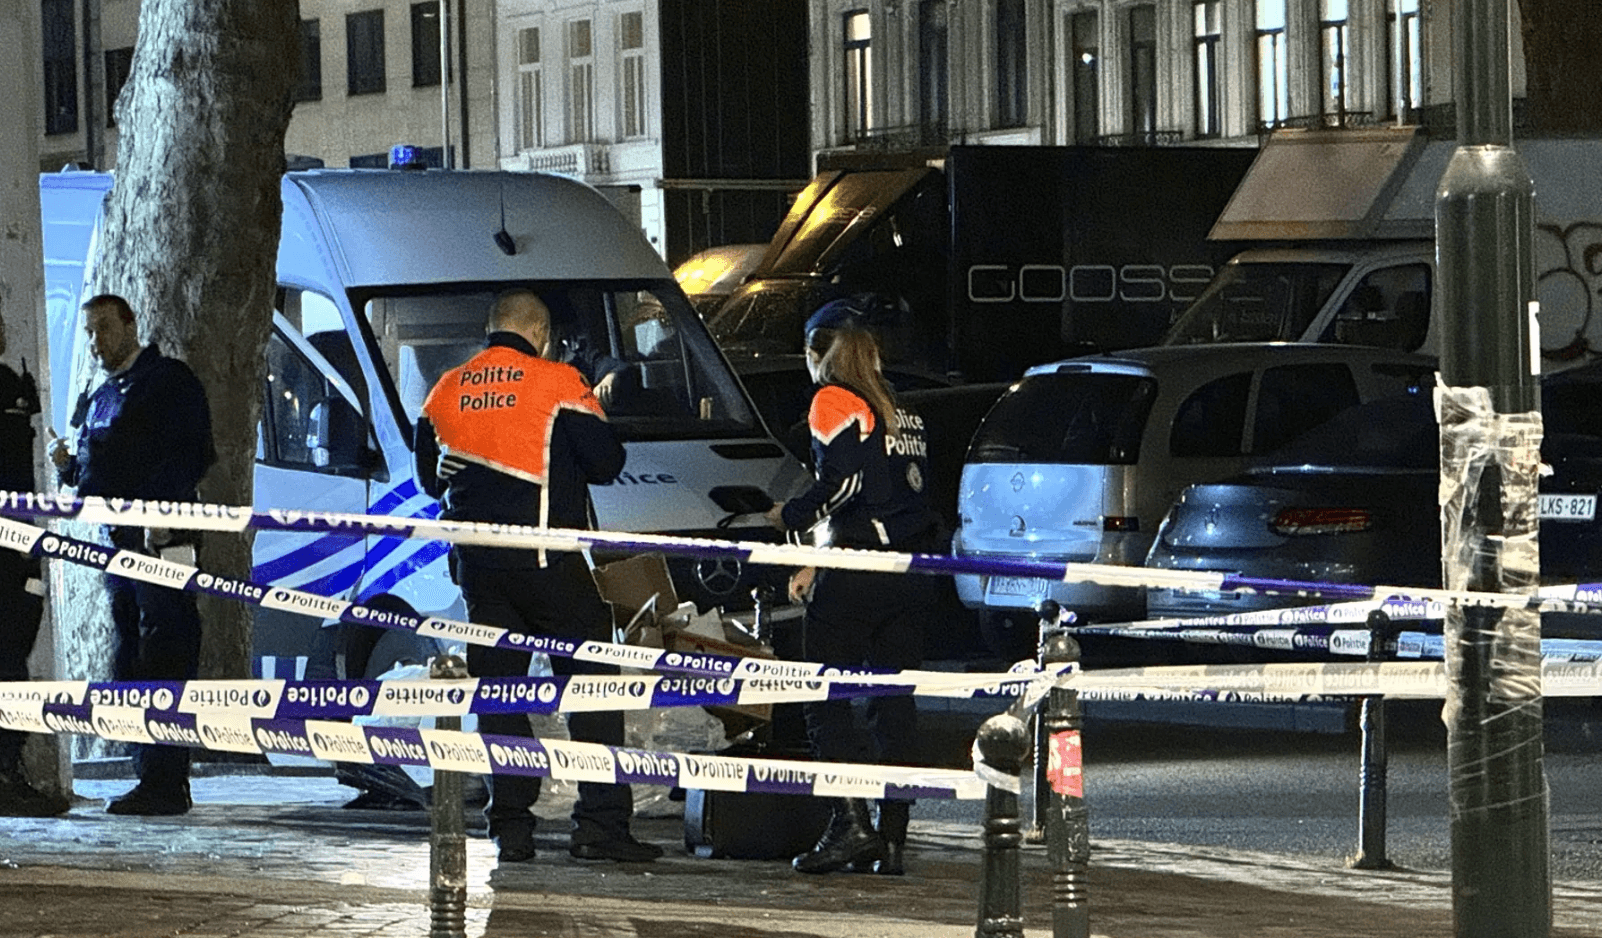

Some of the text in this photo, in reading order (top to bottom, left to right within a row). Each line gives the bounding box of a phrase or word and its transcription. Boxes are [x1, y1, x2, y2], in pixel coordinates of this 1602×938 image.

[460, 366, 525, 387] Politie
[460, 391, 517, 412] Police
[59, 540, 108, 565] Police
[136, 560, 185, 581] Politie
[213, 576, 263, 599] Police
[291, 594, 340, 613] Politie
[369, 609, 418, 628] Police
[447, 623, 496, 640] Politie
[525, 635, 575, 652] Police
[604, 647, 653, 662] Politie
[683, 655, 733, 672] Police
[1393, 603, 1425, 617] Police
[287, 686, 347, 707] Police
[385, 687, 444, 705] Politie
[480, 684, 536, 703] Police
[572, 682, 626, 699] Politie
[660, 678, 716, 696] Police
[90, 688, 150, 709] Police
[190, 689, 248, 707] Politie
[55, 714, 97, 735] Police
[160, 722, 200, 744] Police
[213, 727, 254, 747] Politie
[269, 730, 310, 752] Police
[327, 734, 368, 755] Politie
[385, 736, 427, 760] Police
[445, 741, 486, 764] Politie
[508, 744, 549, 769] Police
[570, 751, 612, 773] Politie
[633, 752, 679, 778] Police
